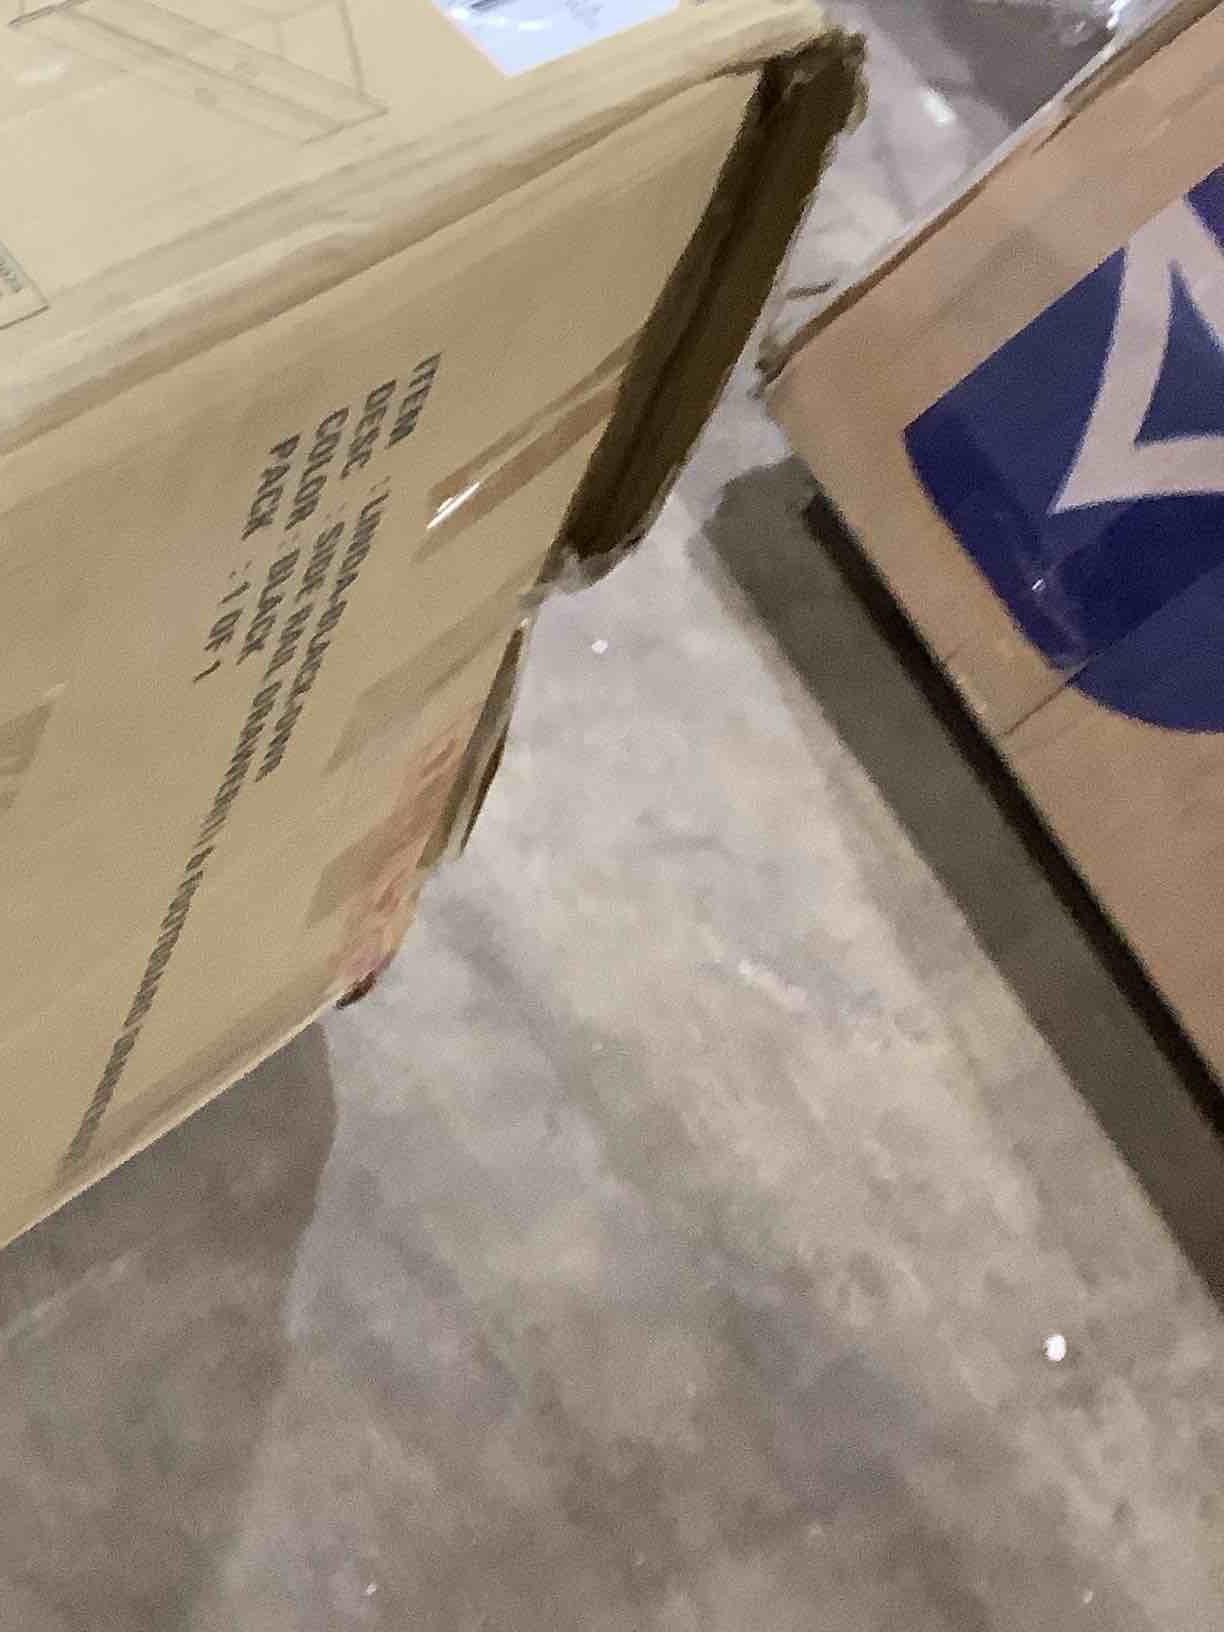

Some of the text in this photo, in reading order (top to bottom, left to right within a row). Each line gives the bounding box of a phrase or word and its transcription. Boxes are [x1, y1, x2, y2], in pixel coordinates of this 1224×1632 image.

[339, 378, 397, 481] DESC
[384, 351, 443, 449] ITEM
[236, 406, 349, 666] COLOR BLACK
[240, 433, 302, 541] PACK
[295, 520, 345, 604] SIDE
[203, 607, 244, 652] OF
